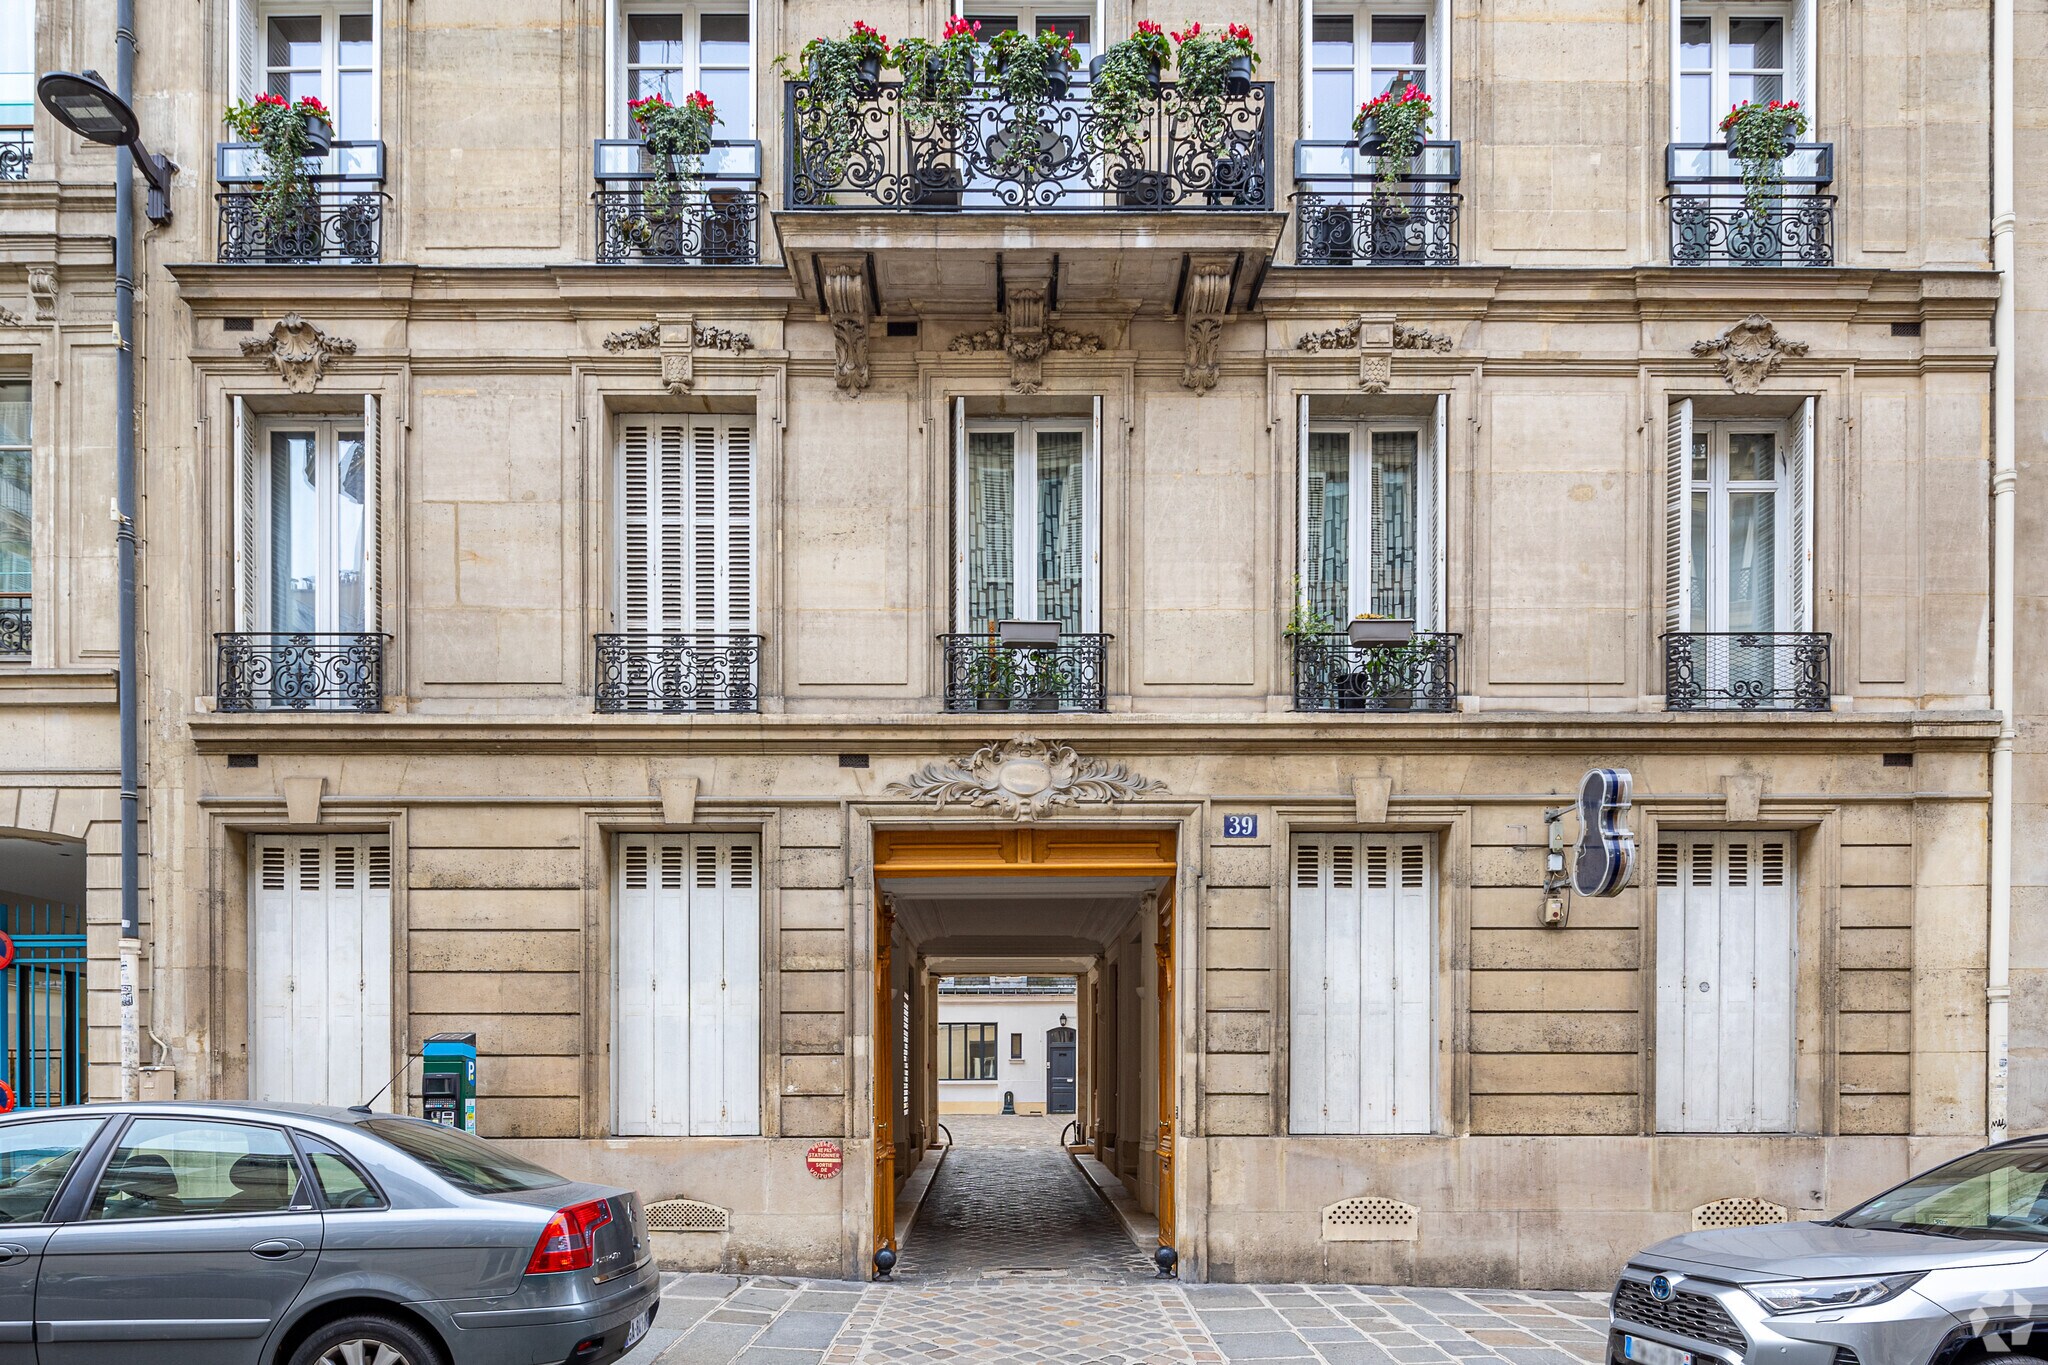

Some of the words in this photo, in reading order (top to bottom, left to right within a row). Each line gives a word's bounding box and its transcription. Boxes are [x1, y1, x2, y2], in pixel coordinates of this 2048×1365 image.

[1229, 816, 1253, 835] 39
[468, 1061, 475, 1081] P
[810, 1167, 840, 1179] VOITURES
